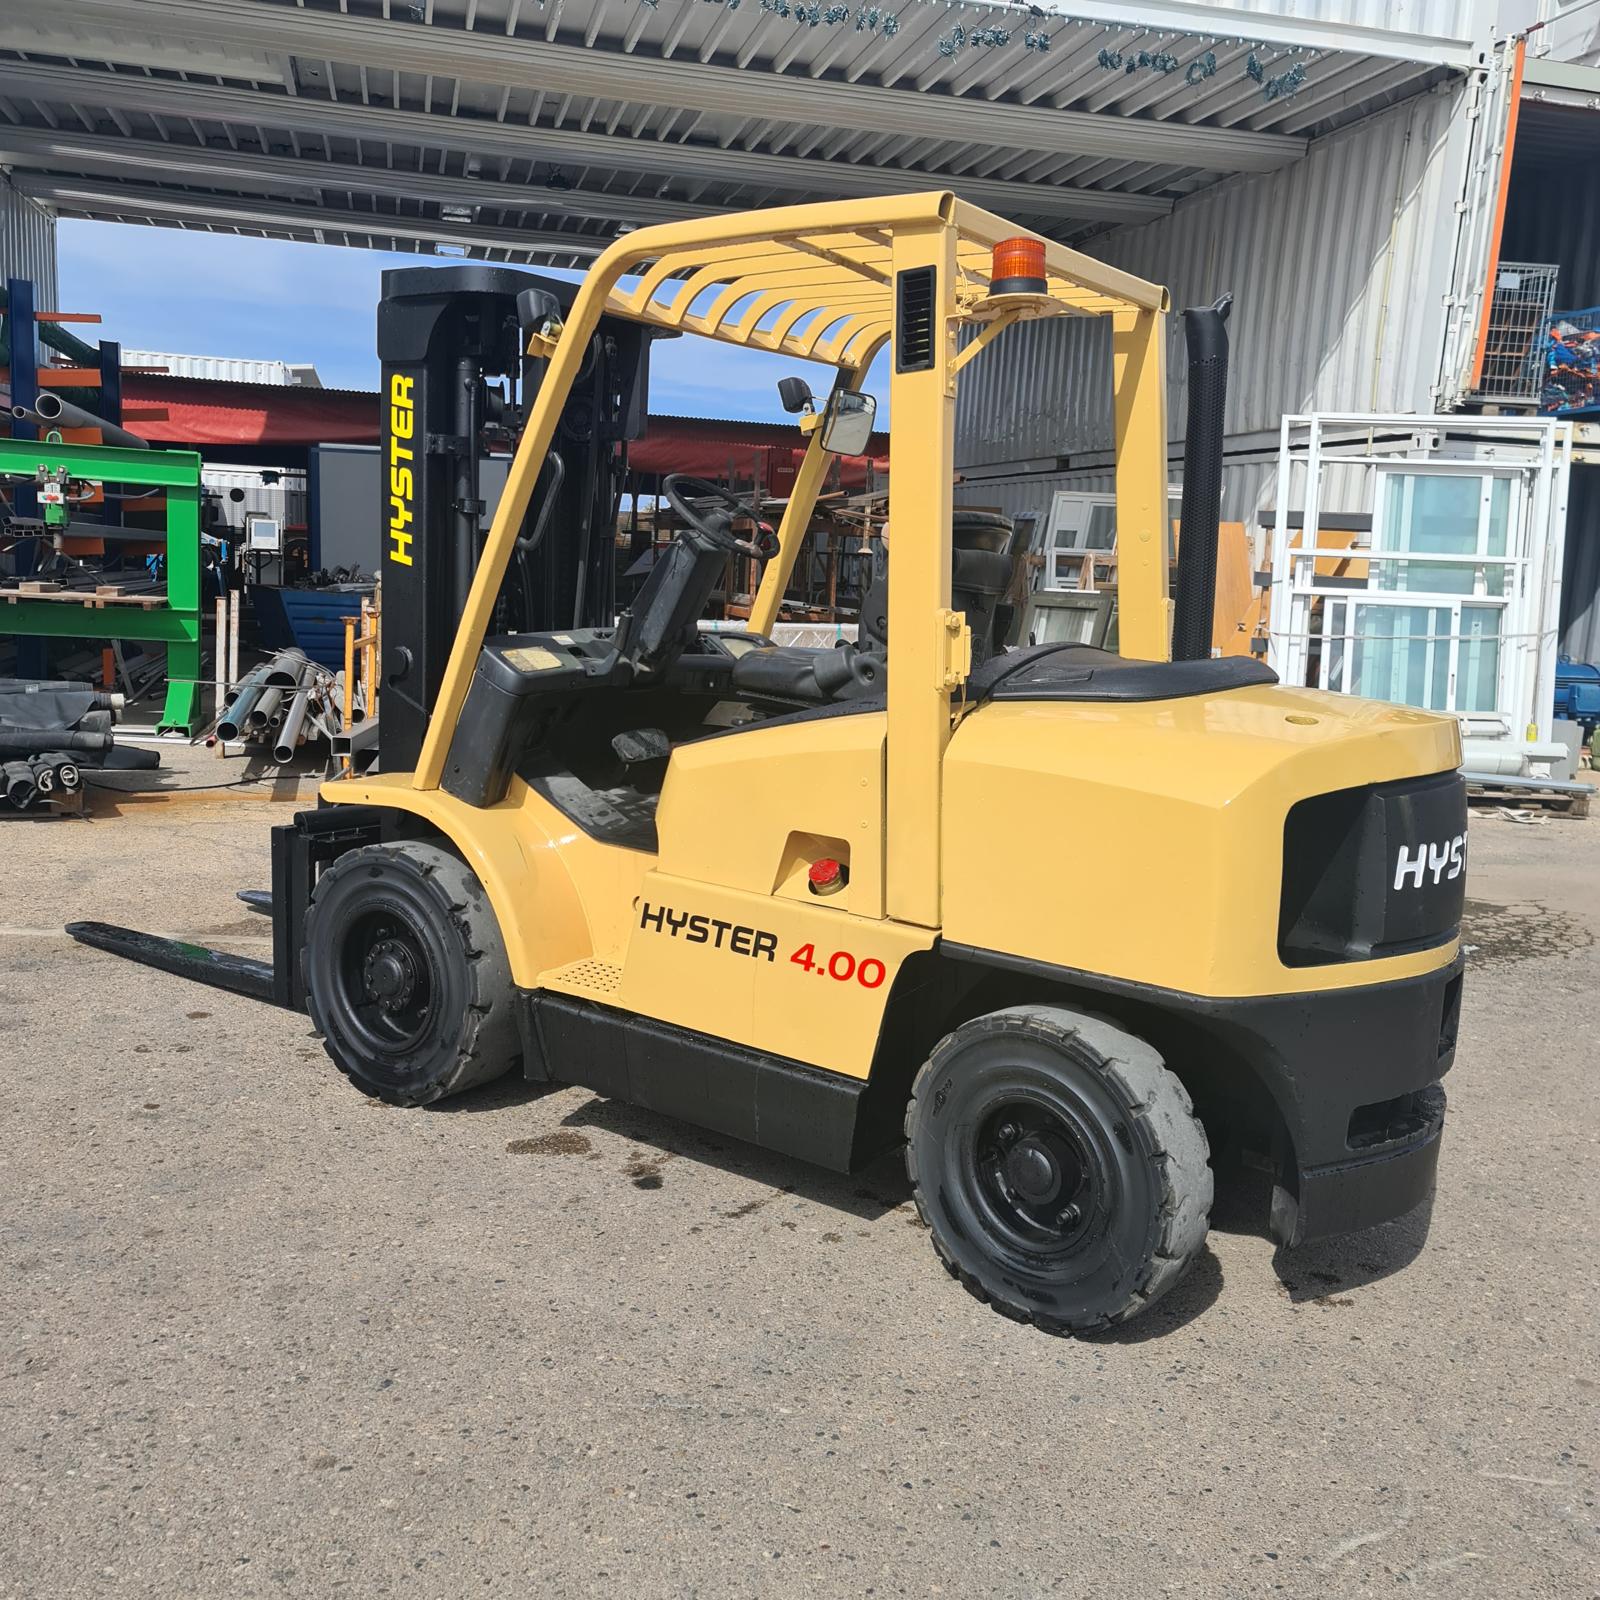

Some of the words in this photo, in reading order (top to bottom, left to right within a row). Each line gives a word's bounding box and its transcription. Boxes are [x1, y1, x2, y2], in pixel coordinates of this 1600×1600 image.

[390, 374, 414, 566] HYSTER
[640, 902, 778, 962] HYSTER
[790, 943, 886, 989] 4.00
